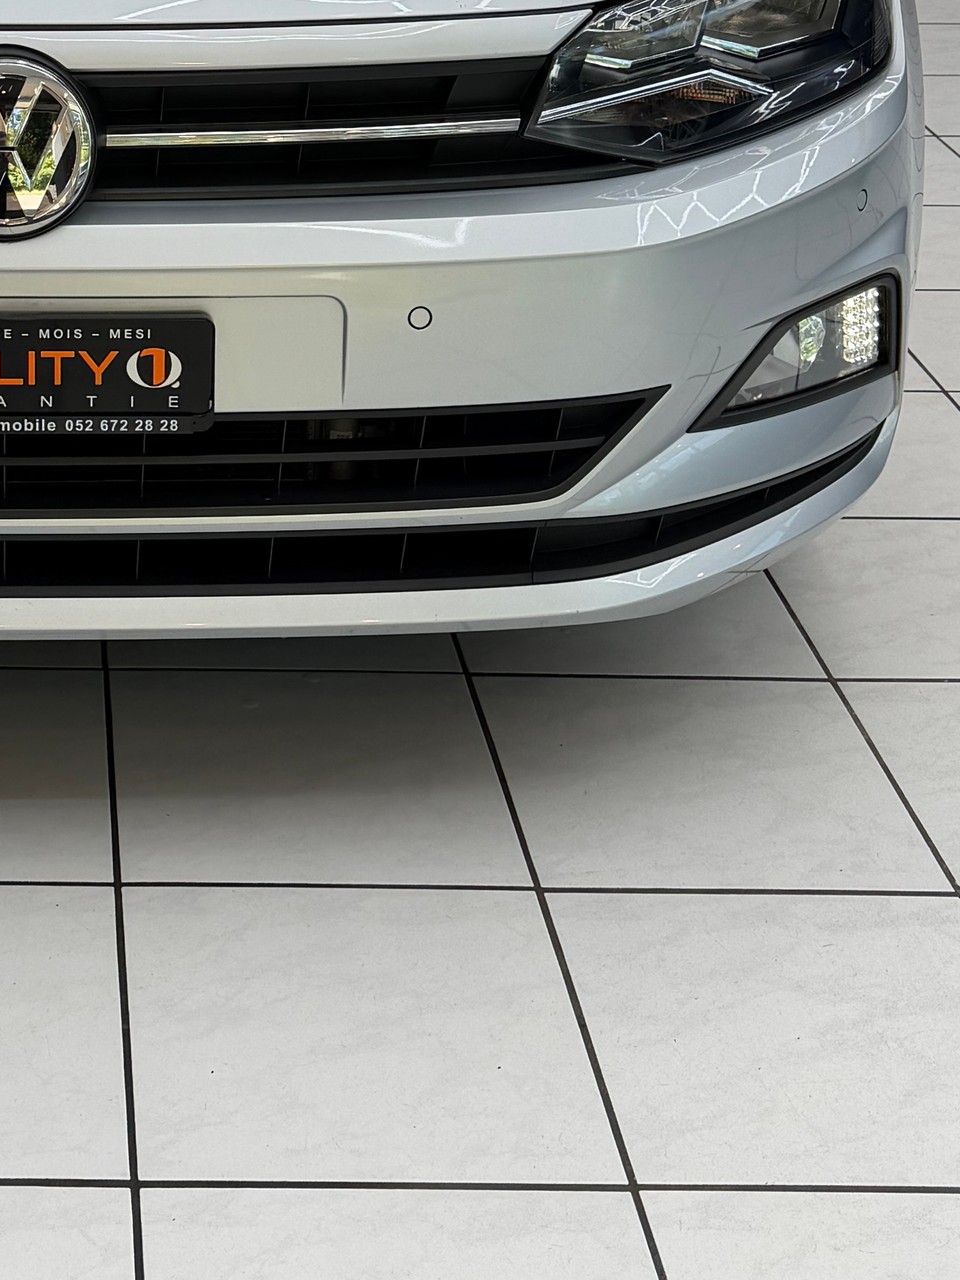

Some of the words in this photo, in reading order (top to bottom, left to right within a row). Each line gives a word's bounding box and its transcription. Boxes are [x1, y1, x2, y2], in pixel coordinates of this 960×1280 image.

[39, 328, 83, 340] MOIS
[109, 328, 151, 340] MESI
[65, 419, 93, 432] 052
[100, 419, 128, 432] 672
[135, 419, 153, 432] 28
[159, 419, 179, 432] 28
